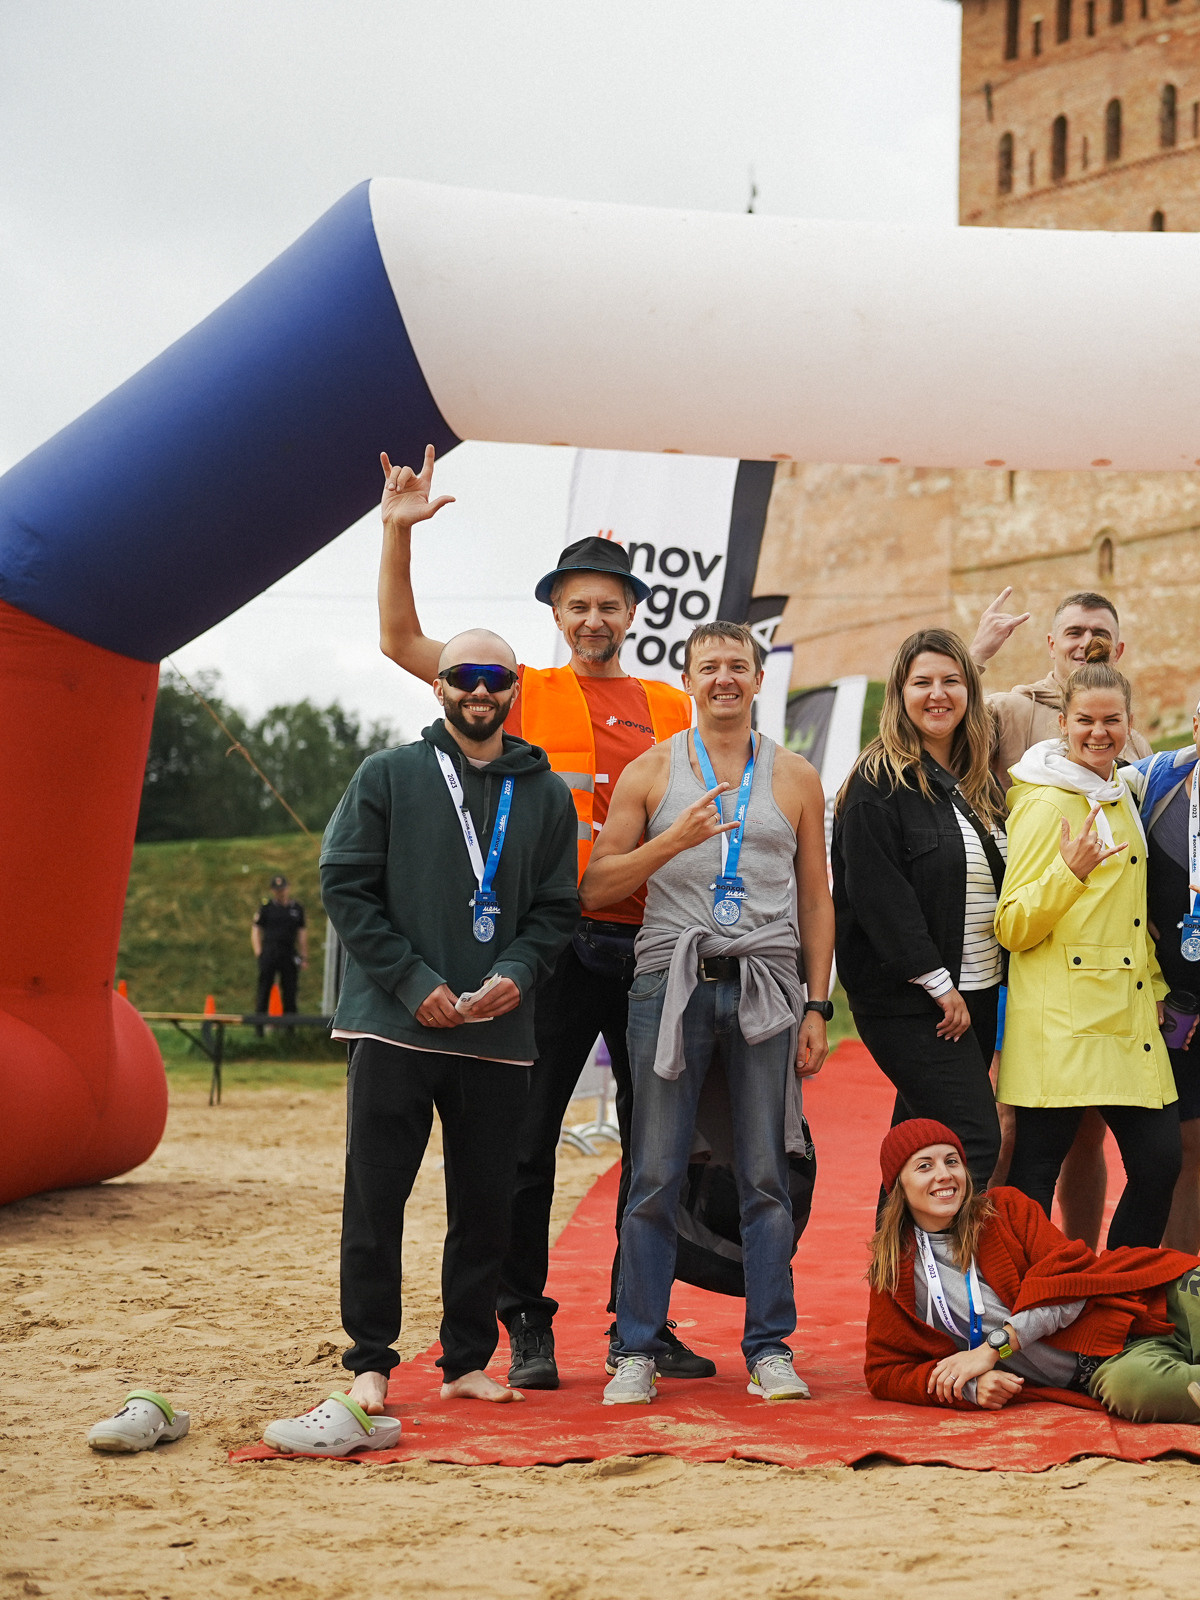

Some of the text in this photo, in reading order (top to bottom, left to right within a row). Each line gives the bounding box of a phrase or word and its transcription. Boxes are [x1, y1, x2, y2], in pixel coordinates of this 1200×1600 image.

[644, 584, 710, 629] go
[447, 773, 458, 789] 2023
[504, 779, 512, 796] 2023
[742, 772, 751, 787] 2023
[928, 1264, 937, 1279] 2023
